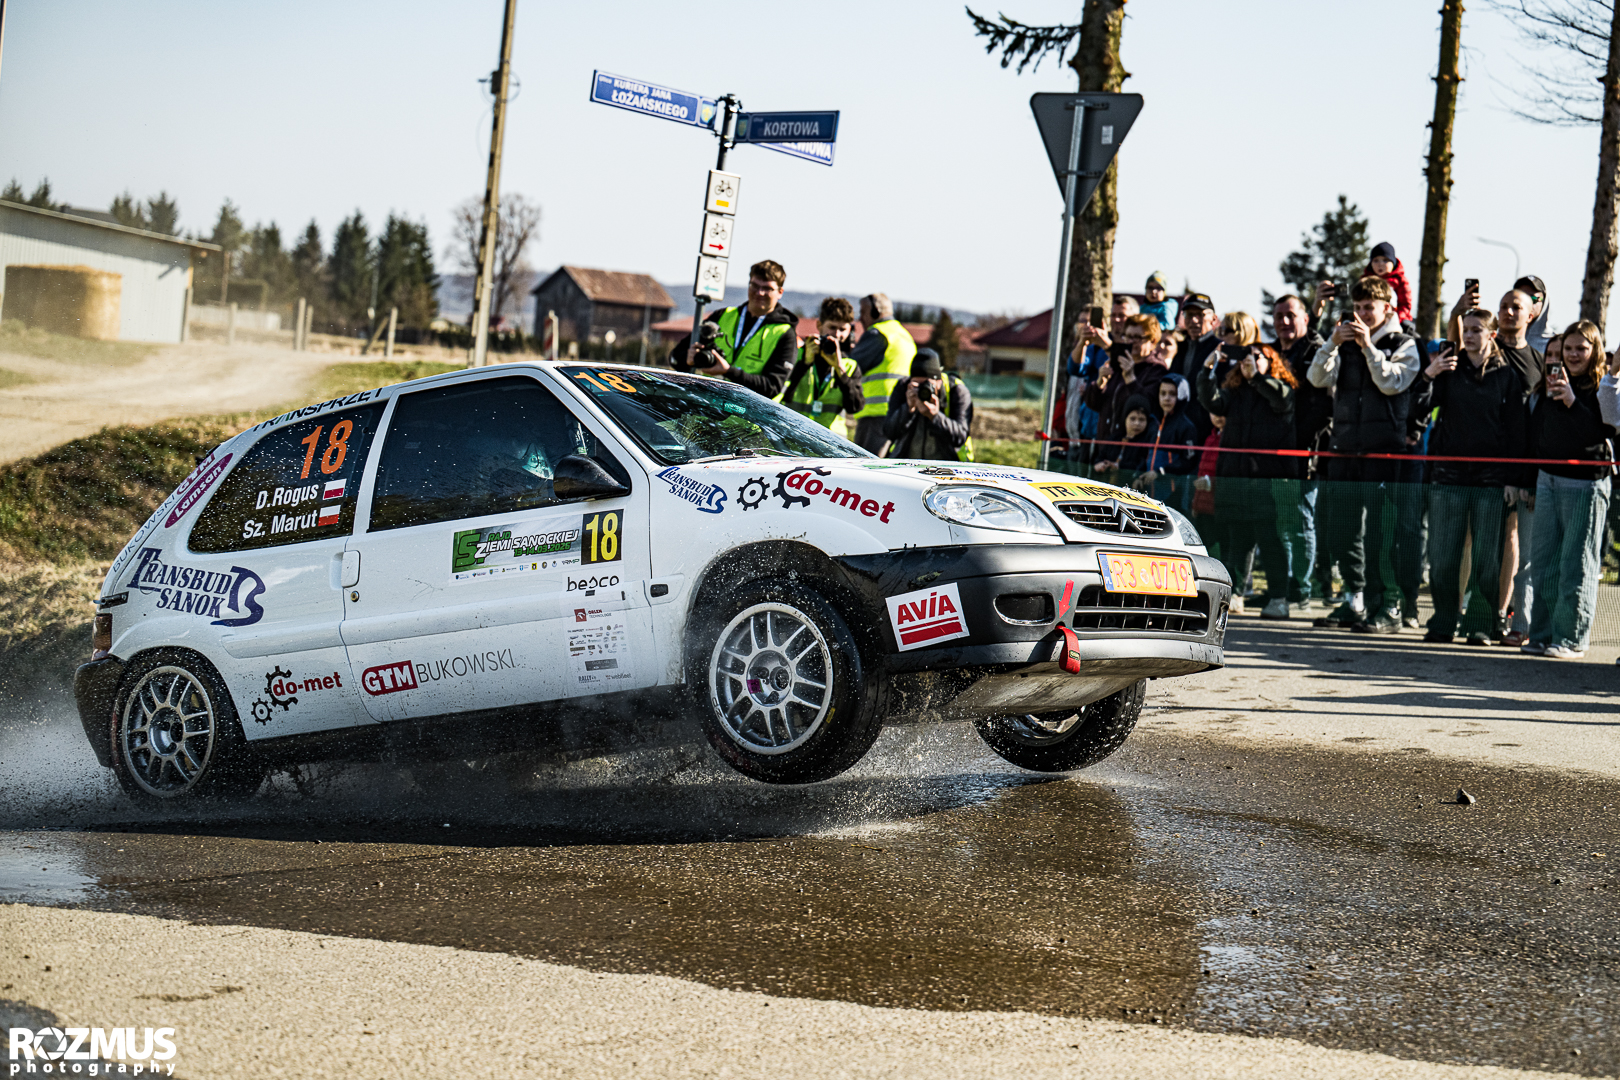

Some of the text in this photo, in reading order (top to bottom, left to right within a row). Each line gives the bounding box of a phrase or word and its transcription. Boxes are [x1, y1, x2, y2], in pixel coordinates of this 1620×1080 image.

[611, 90, 689, 119] ŁOŻAŃSKIEGO
[613, 79, 649, 95] KURIERA
[651, 88, 672, 101] JANA
[763, 121, 820, 137] KORTOWA
[573, 372, 637, 393] 18
[300, 419, 354, 480] 18
[174, 465, 222, 519] Lamsan
[655, 466, 712, 496] TRANSBUD
[668, 484, 707, 507] SANOK
[255, 483, 318, 510] D.Rogus
[786, 472, 895, 524] do-met
[242, 509, 317, 539] Sz. Marut
[488, 531, 512, 542] RAJD
[585, 512, 619, 562] 18
[474, 529, 580, 559] ZIEMI SANOCKIEJ
[126, 547, 233, 595] TRANSBUD
[1111, 559, 1188, 592] R3 0719
[156, 588, 226, 618] SANOK
[273, 671, 342, 697] do-met
[364, 649, 515, 693] GTM BUKOWSKI
